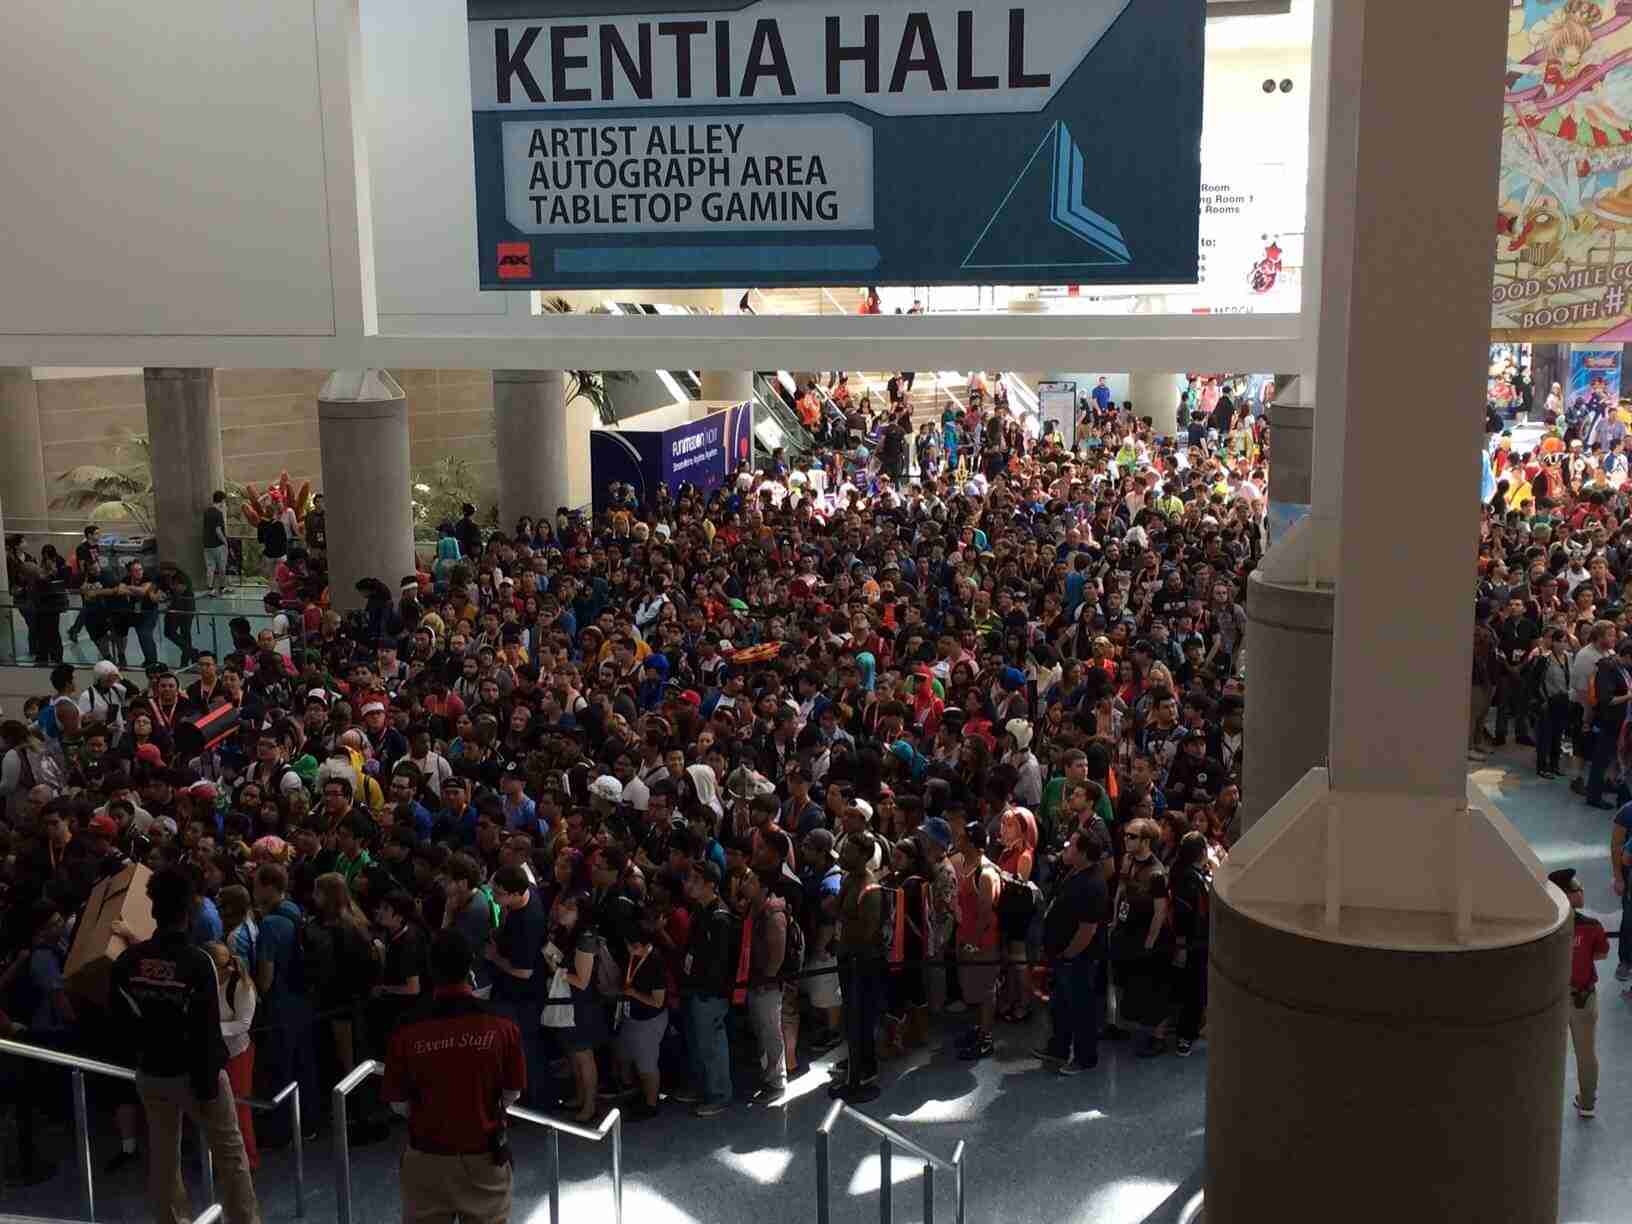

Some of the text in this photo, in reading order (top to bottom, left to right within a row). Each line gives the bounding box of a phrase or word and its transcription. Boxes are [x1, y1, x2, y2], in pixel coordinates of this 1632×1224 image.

[494, 8, 1051, 104] KENTIA HALL
[528, 124, 744, 158] ARTIST ALLEY
[528, 155, 827, 190] AUTOGRAPH AREA
[1200, 183, 1230, 192] Room
[529, 191, 839, 224] TABLETOP GAMING
[1205, 205, 1240, 214] Rooms
[1215, 195, 1245, 204] Room
[1490, 279, 1540, 303] OOD
[1546, 269, 1605, 292] SMILE
[1523, 301, 1597, 328] BOOTH
[414, 1030, 496, 1055] Event Staff
